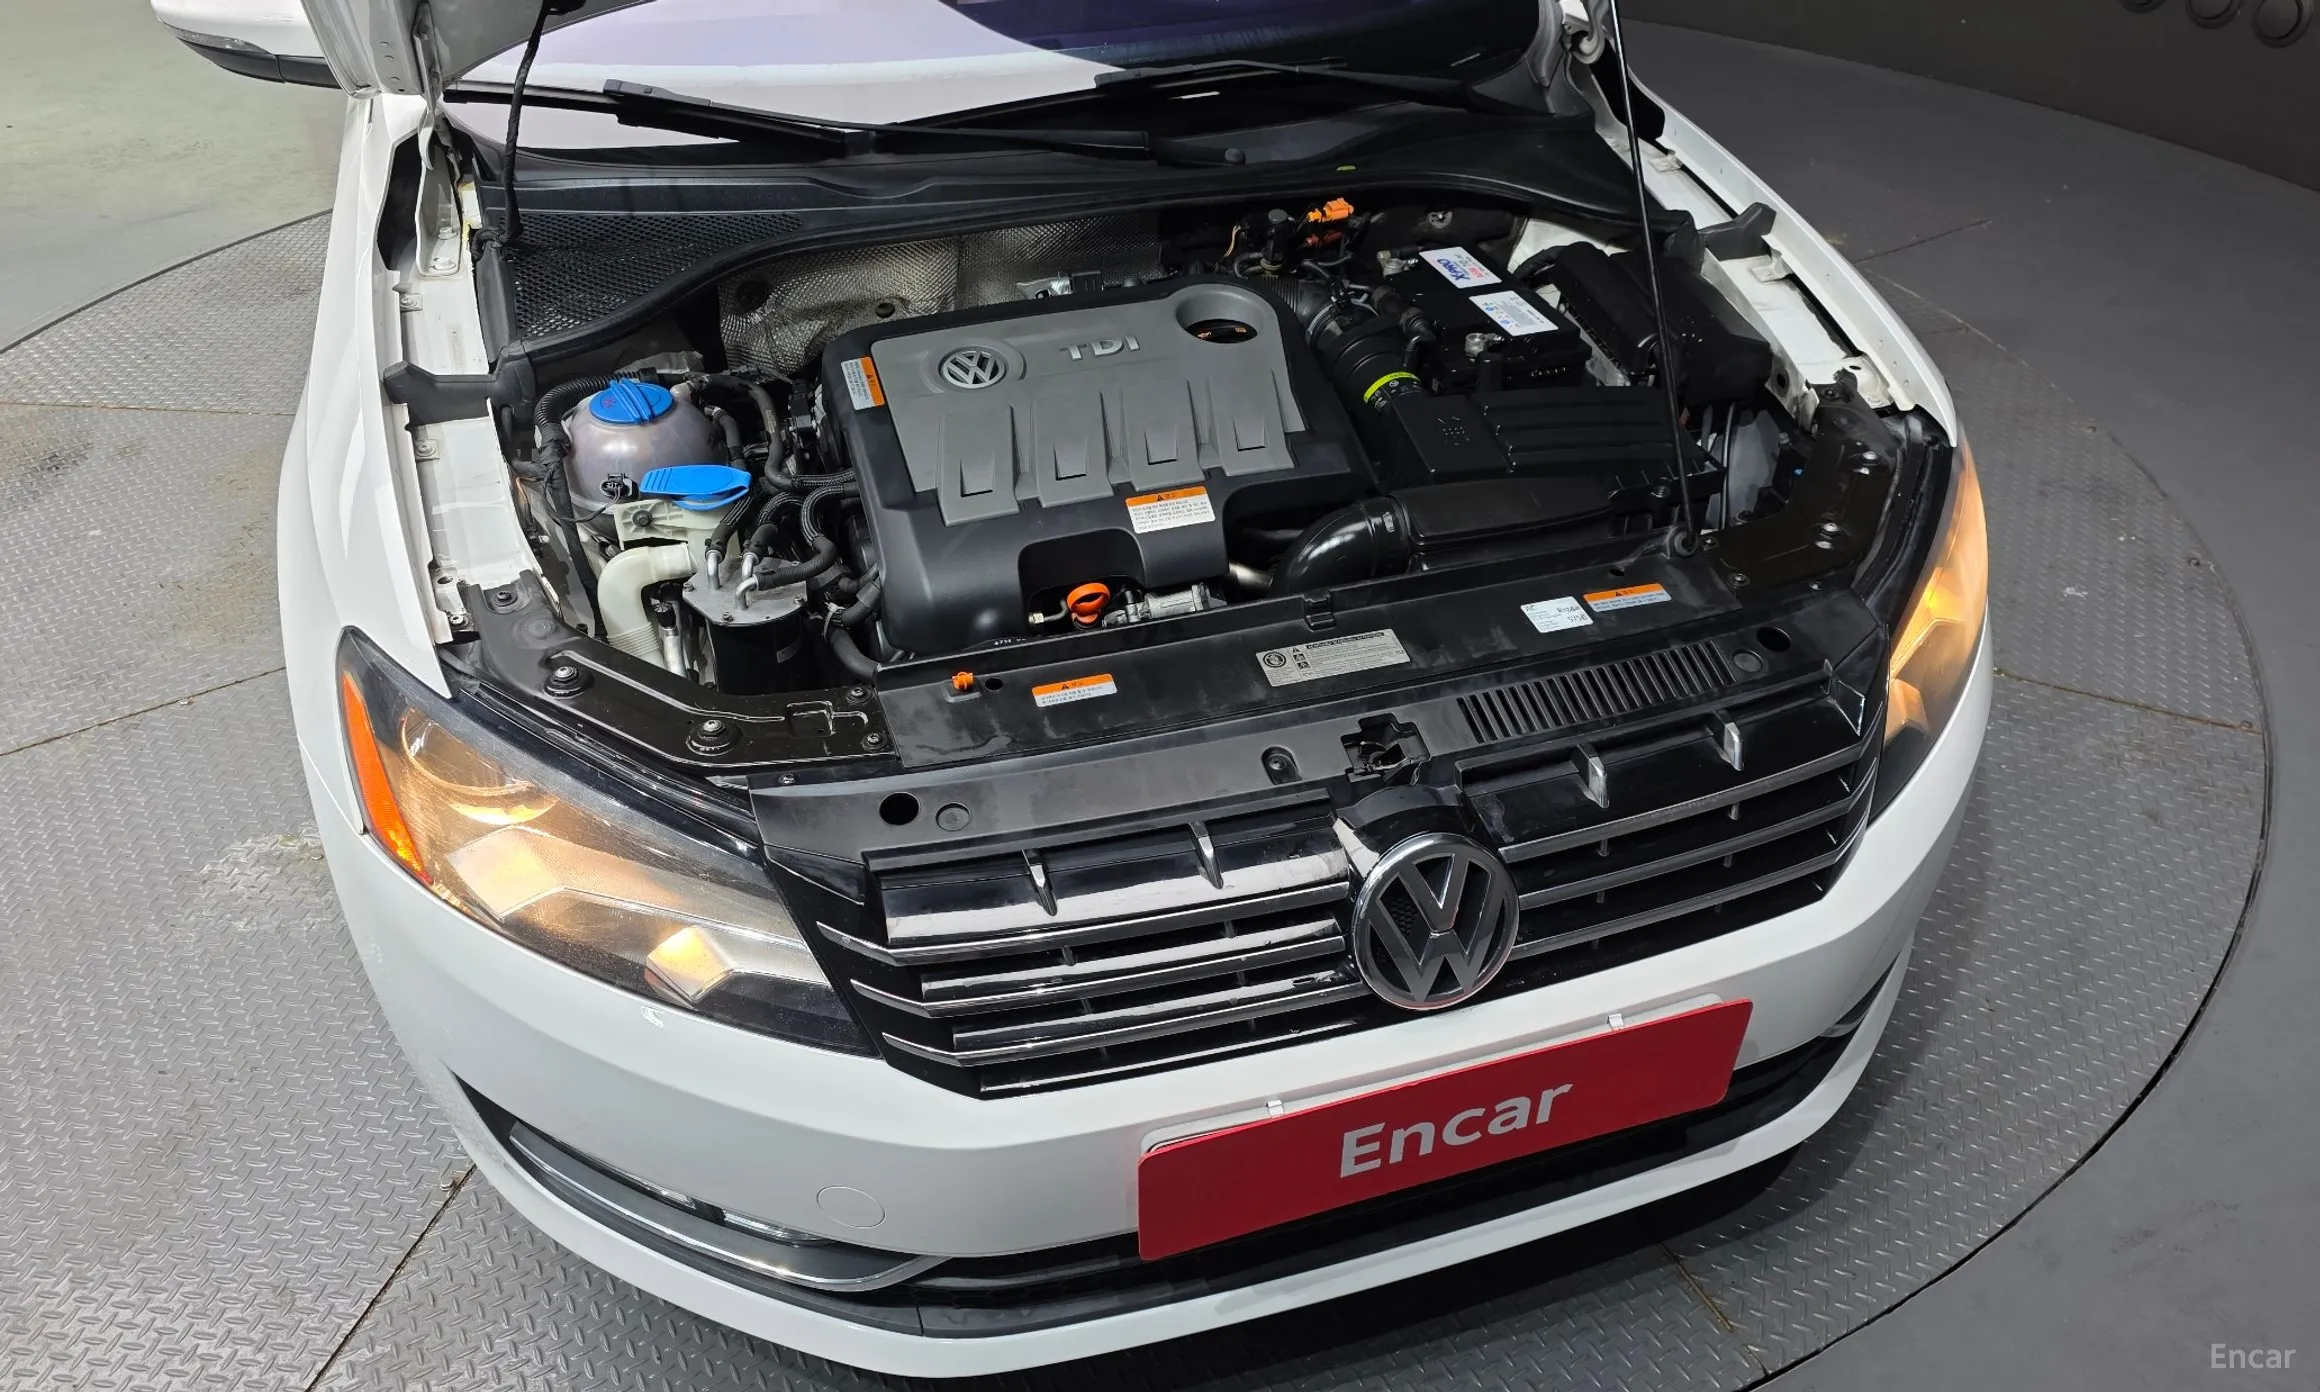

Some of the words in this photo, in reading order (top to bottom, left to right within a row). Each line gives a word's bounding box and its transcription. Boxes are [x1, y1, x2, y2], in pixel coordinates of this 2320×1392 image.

[942, 349, 1004, 388] VW
[1060, 336, 1140, 361] TDI
[1361, 842, 1510, 1004] VW
[1340, 1083, 1573, 1178] Encar
